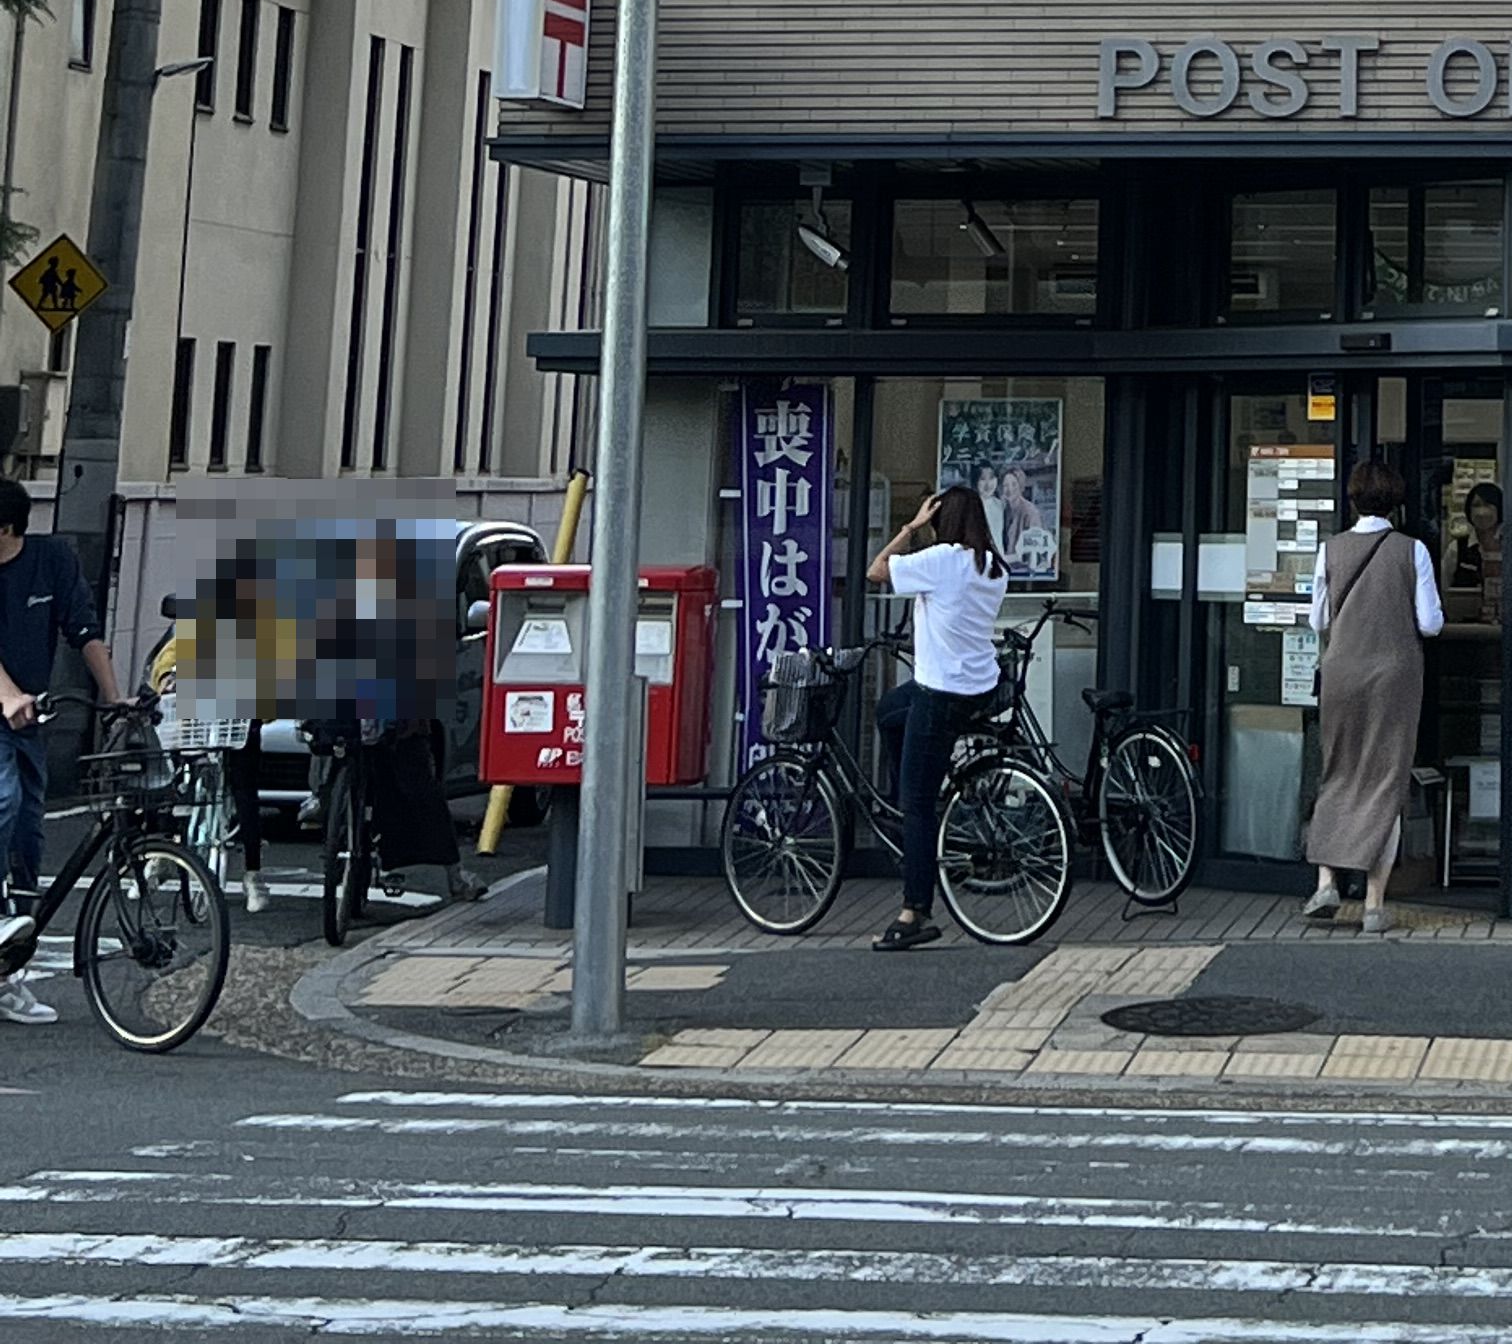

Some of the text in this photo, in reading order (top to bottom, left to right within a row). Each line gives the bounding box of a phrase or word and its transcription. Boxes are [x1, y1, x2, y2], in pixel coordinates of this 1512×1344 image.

[1098, 37, 1379, 118] POST
[754, 400, 814, 664] 喪中はが
[563, 725, 585, 744] POS
